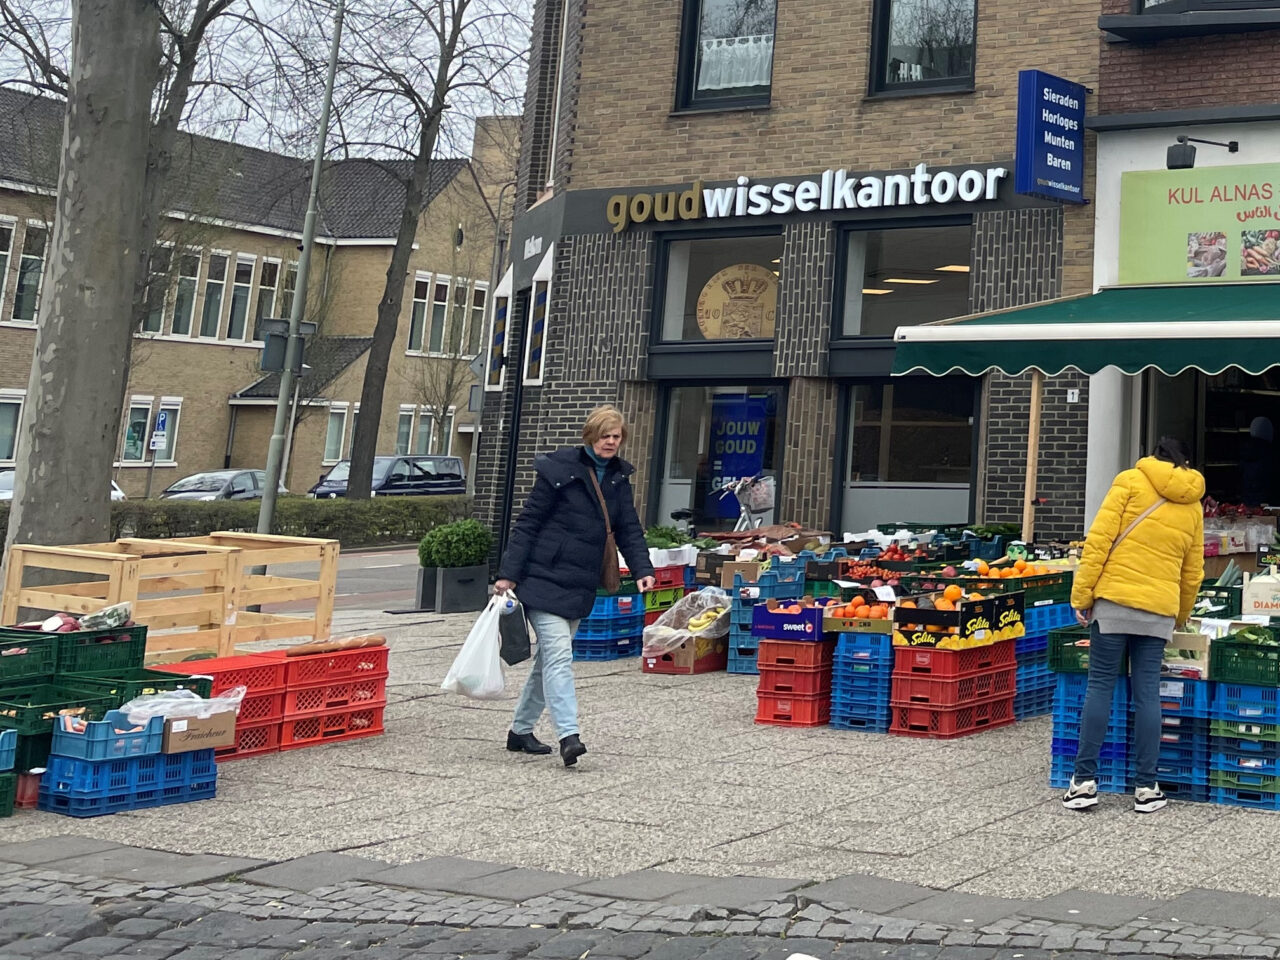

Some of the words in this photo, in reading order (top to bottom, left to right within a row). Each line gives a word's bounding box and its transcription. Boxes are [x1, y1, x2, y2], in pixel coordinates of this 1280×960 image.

[1043, 88, 1079, 110] Sieraden
[1042, 108, 1078, 131] Horloges
[1044, 131, 1075, 151] Munten
[1047, 153, 1071, 171] Baren
[606, 163, 1008, 233] goudwisselkantoor
[1168, 187, 1204, 205] KUL
[1210, 183, 1273, 203] ALNAS
[159, 413, 166, 424] P
[717, 421, 760, 435] JOUW
[715, 440, 757, 454] GOUD
[965, 616, 990, 635] Solita
[999, 609, 1021, 627] Solita
[911, 632, 936, 645] Solita
